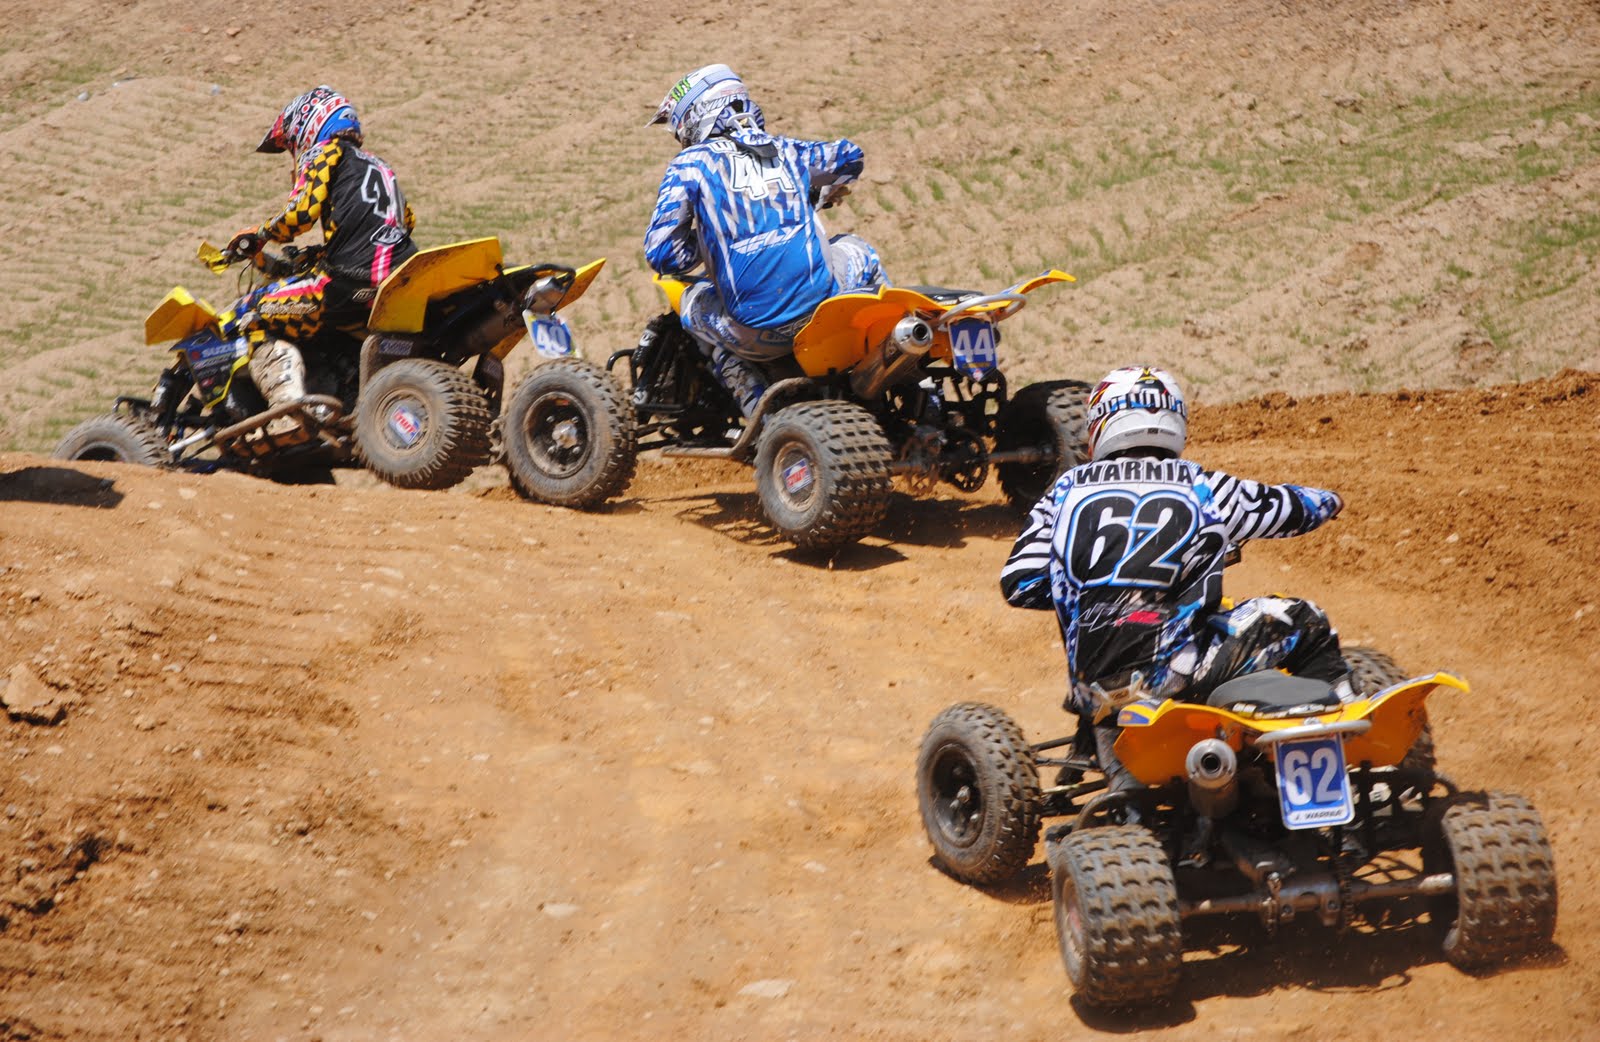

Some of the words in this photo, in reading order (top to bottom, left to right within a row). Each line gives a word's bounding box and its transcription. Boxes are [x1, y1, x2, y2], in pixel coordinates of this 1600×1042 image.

[537, 322, 569, 354] 40
[954, 328, 994, 364] 44
[1076, 460, 1193, 485] WARNIA
[1065, 489, 1199, 590] 62
[1284, 746, 1343, 807] 62
